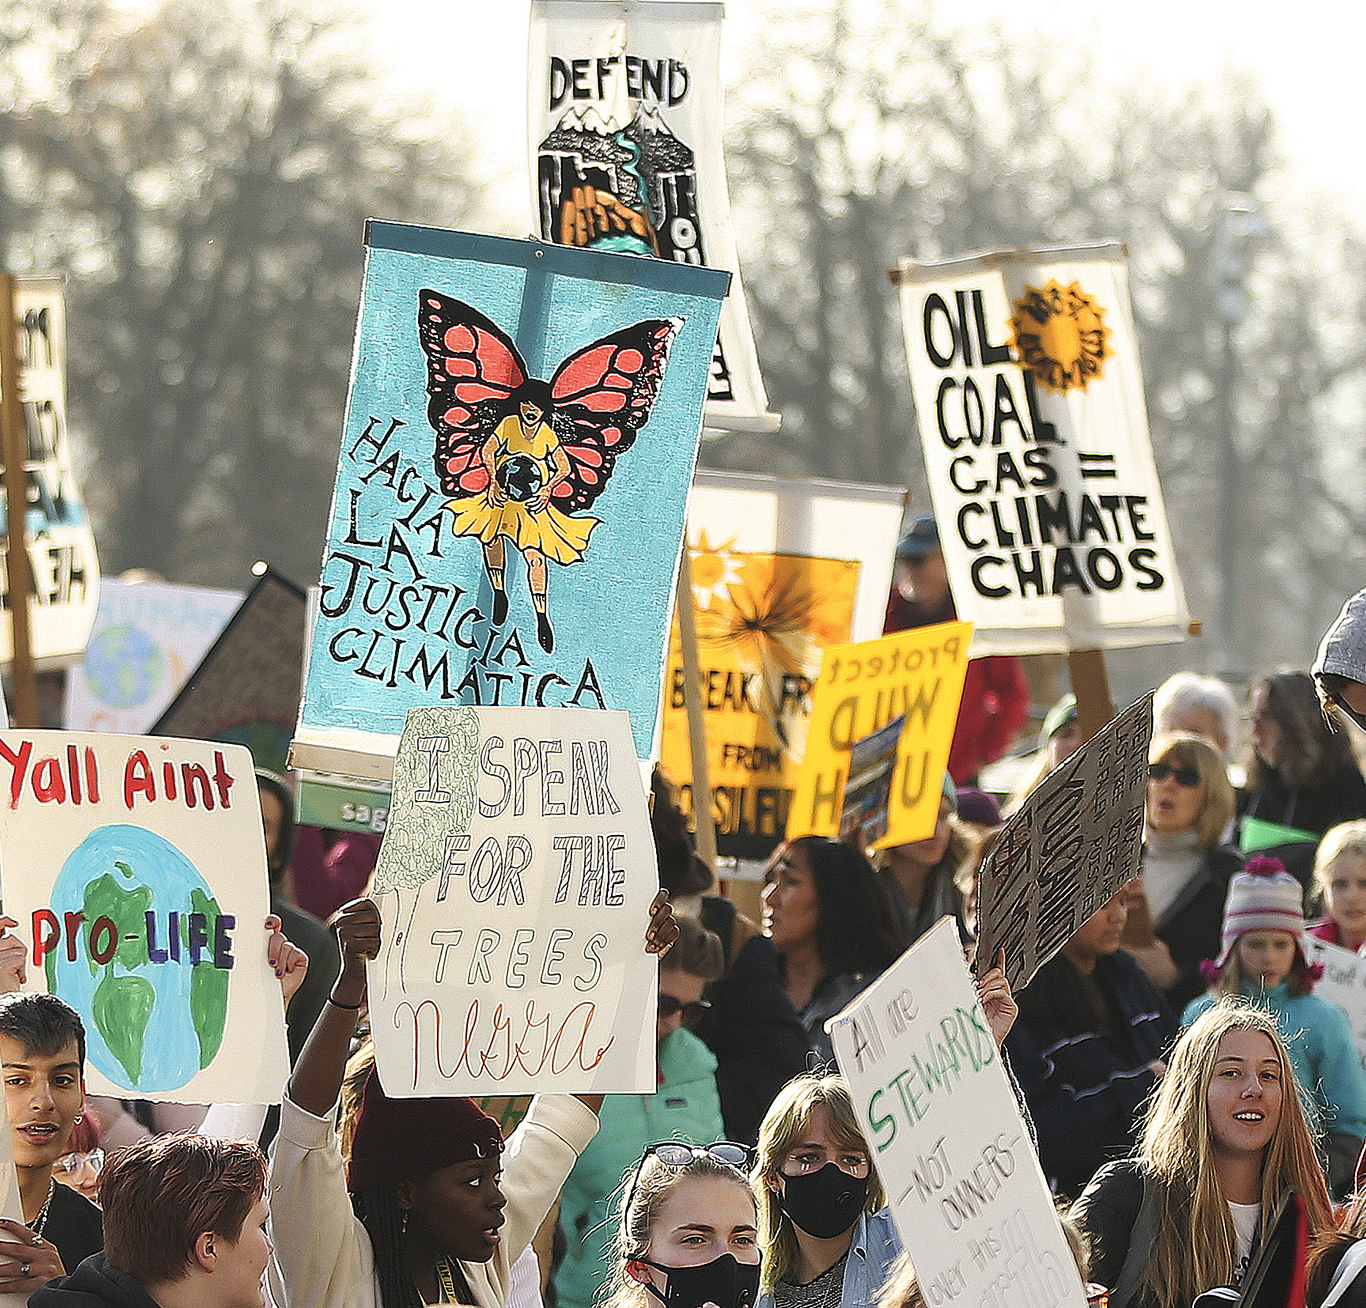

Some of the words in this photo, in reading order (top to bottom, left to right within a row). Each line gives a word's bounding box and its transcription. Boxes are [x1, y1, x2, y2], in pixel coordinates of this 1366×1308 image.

[549, 55, 689, 112] DEFEND
[922, 288, 1014, 369] OIL
[936, 368, 1065, 450] COAL
[346, 415, 443, 558] HACIA
[949, 446, 1058, 494] GAS
[343, 490, 423, 581] LA
[956, 494, 1156, 551] CLIMATE
[320, 550, 532, 669] JUSTICIA
[969, 548, 1164, 598] CHAOS
[414, 736, 451, 803] I
[478, 735, 623, 818] SPEAK
[436, 835, 534, 907] FOR
[553, 834, 626, 907] THE
[430, 928, 608, 991] TREES
[848, 1005, 887, 1075] All
[865, 1002, 995, 1154] STEWARDS
